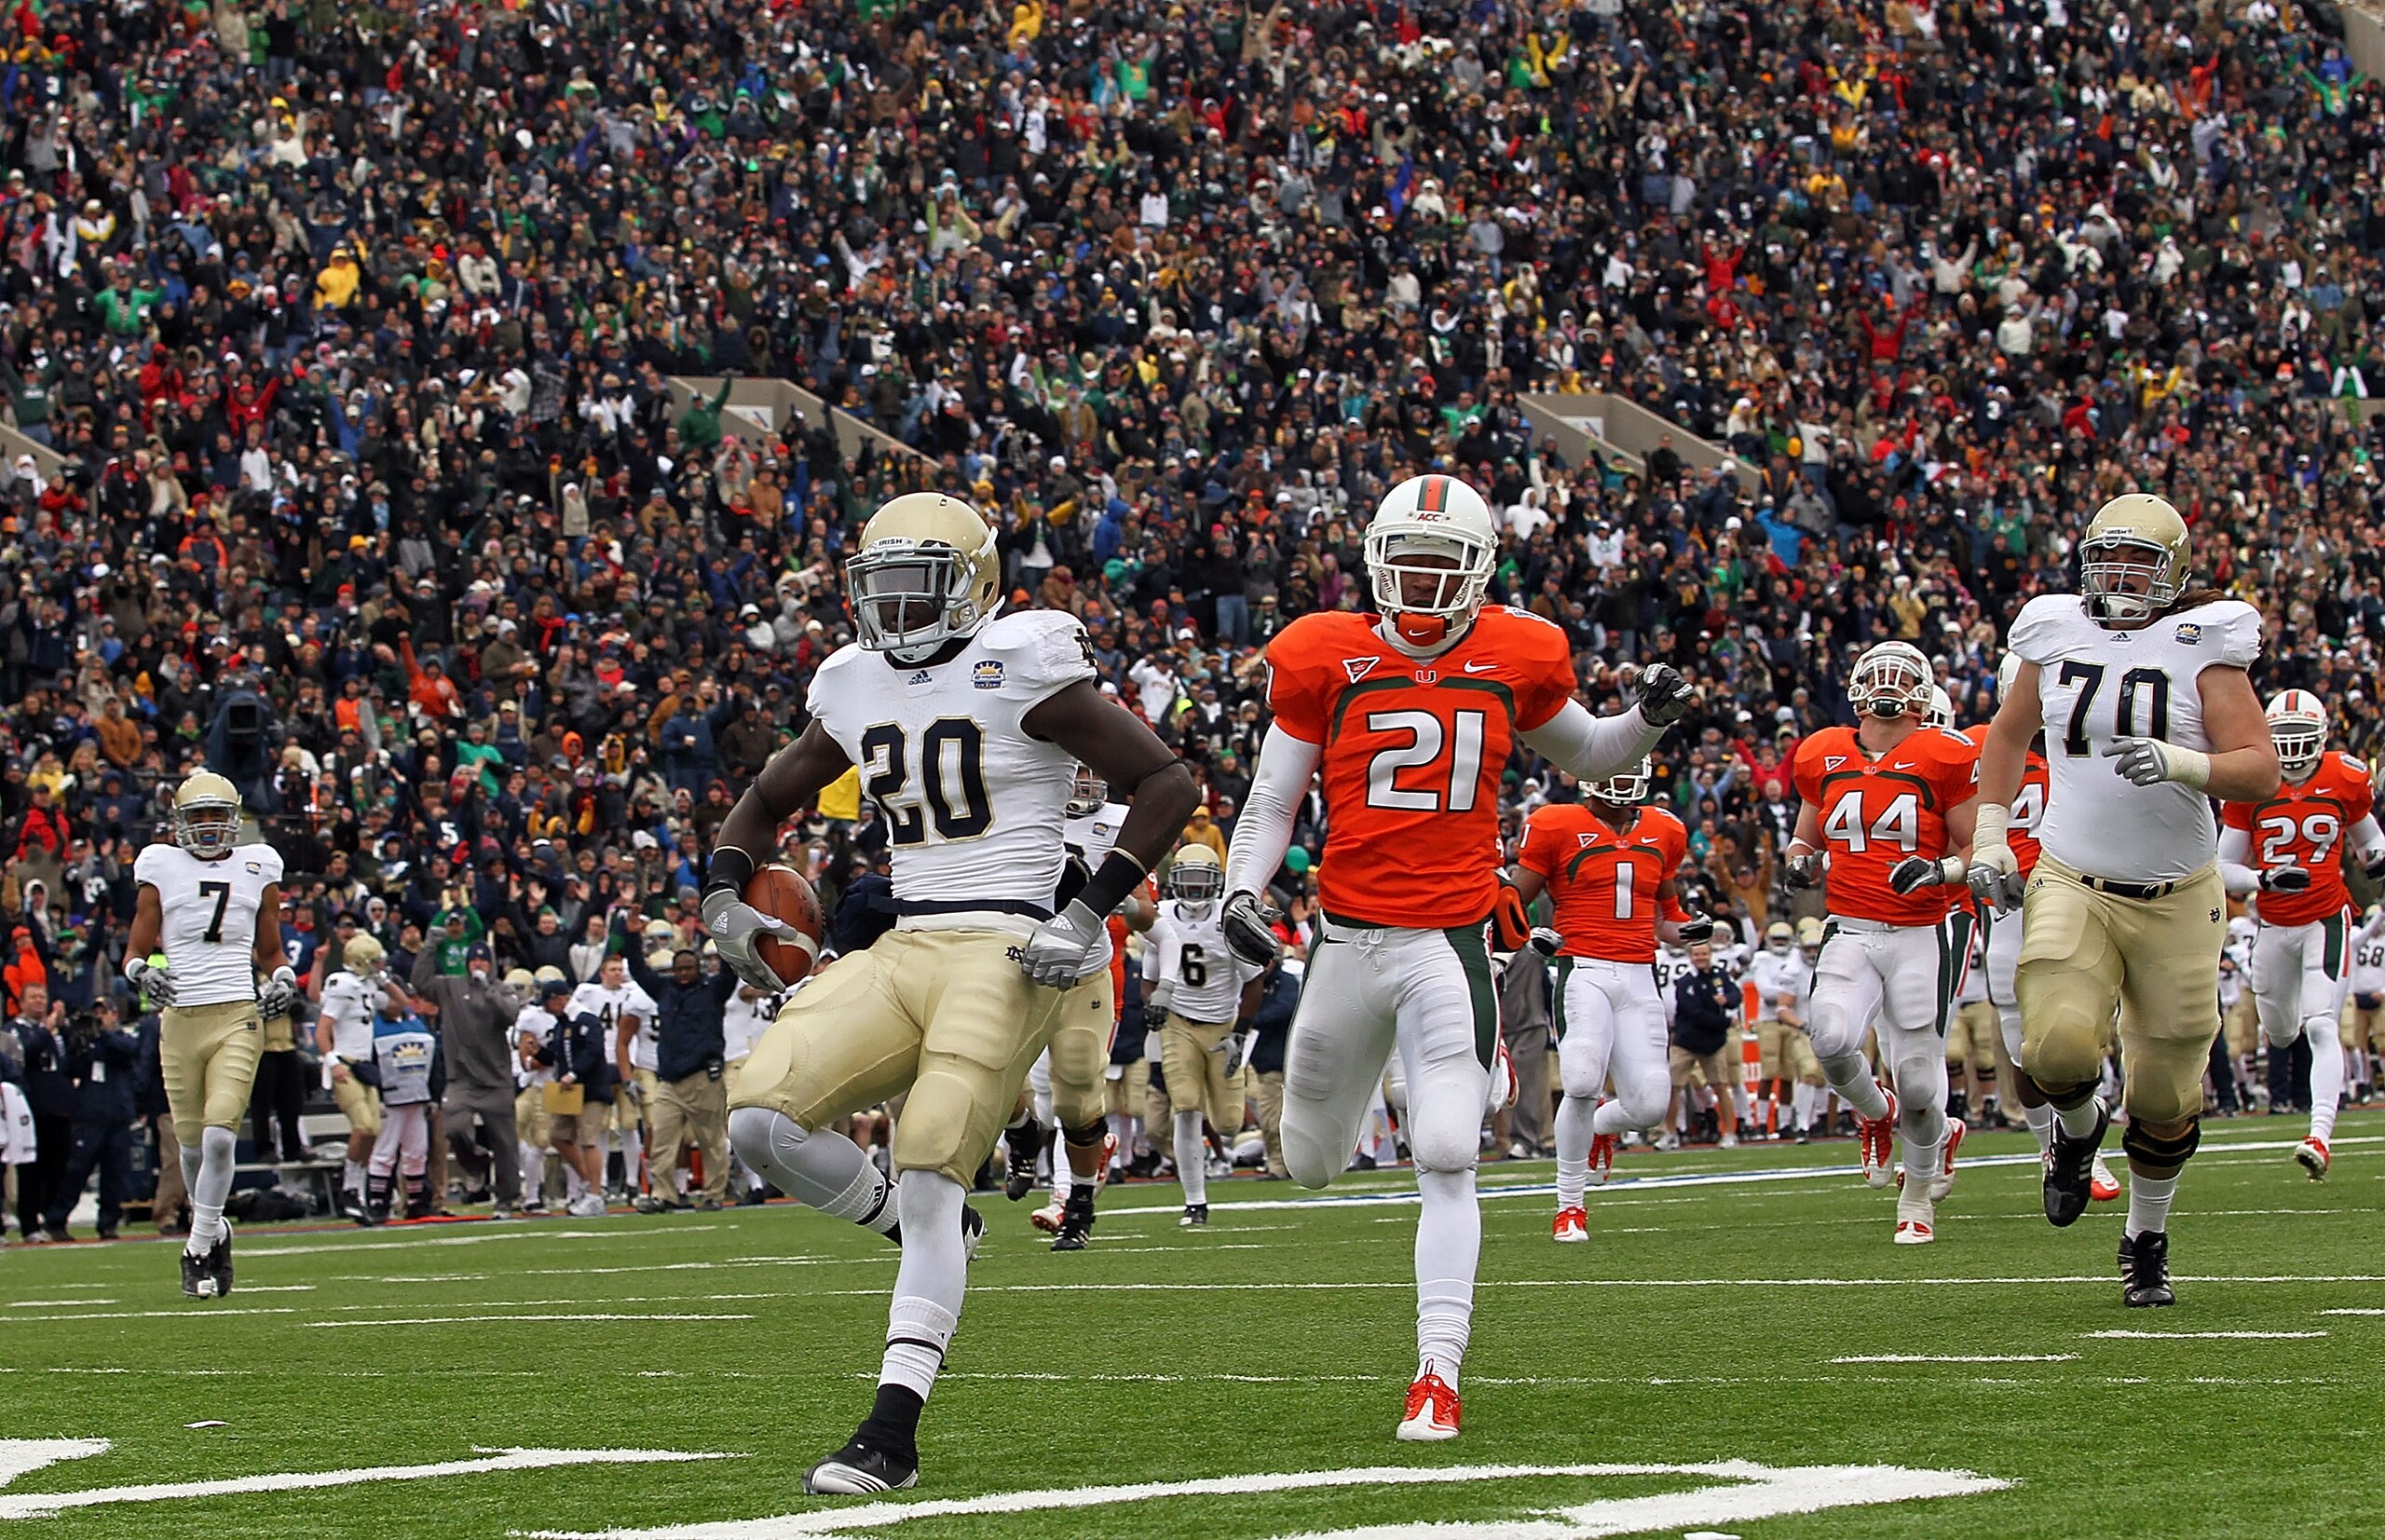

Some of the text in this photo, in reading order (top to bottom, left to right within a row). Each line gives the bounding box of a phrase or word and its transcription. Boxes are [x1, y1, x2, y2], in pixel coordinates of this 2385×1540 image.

[1417, 512, 1441, 523] ACC
[2056, 658, 2172, 758] 70
[859, 715, 996, 851] 20
[1365, 708, 1486, 812] 21
[441, 821, 459, 845] 5
[1823, 790, 1918, 853] 44
[2258, 813, 2341, 865] 29
[198, 880, 231, 944] 7
[1615, 861, 1634, 920] 1
[286, 939, 303, 967] 3
[1180, 943, 1206, 988] 6
[2356, 945, 2385, 967] 68
